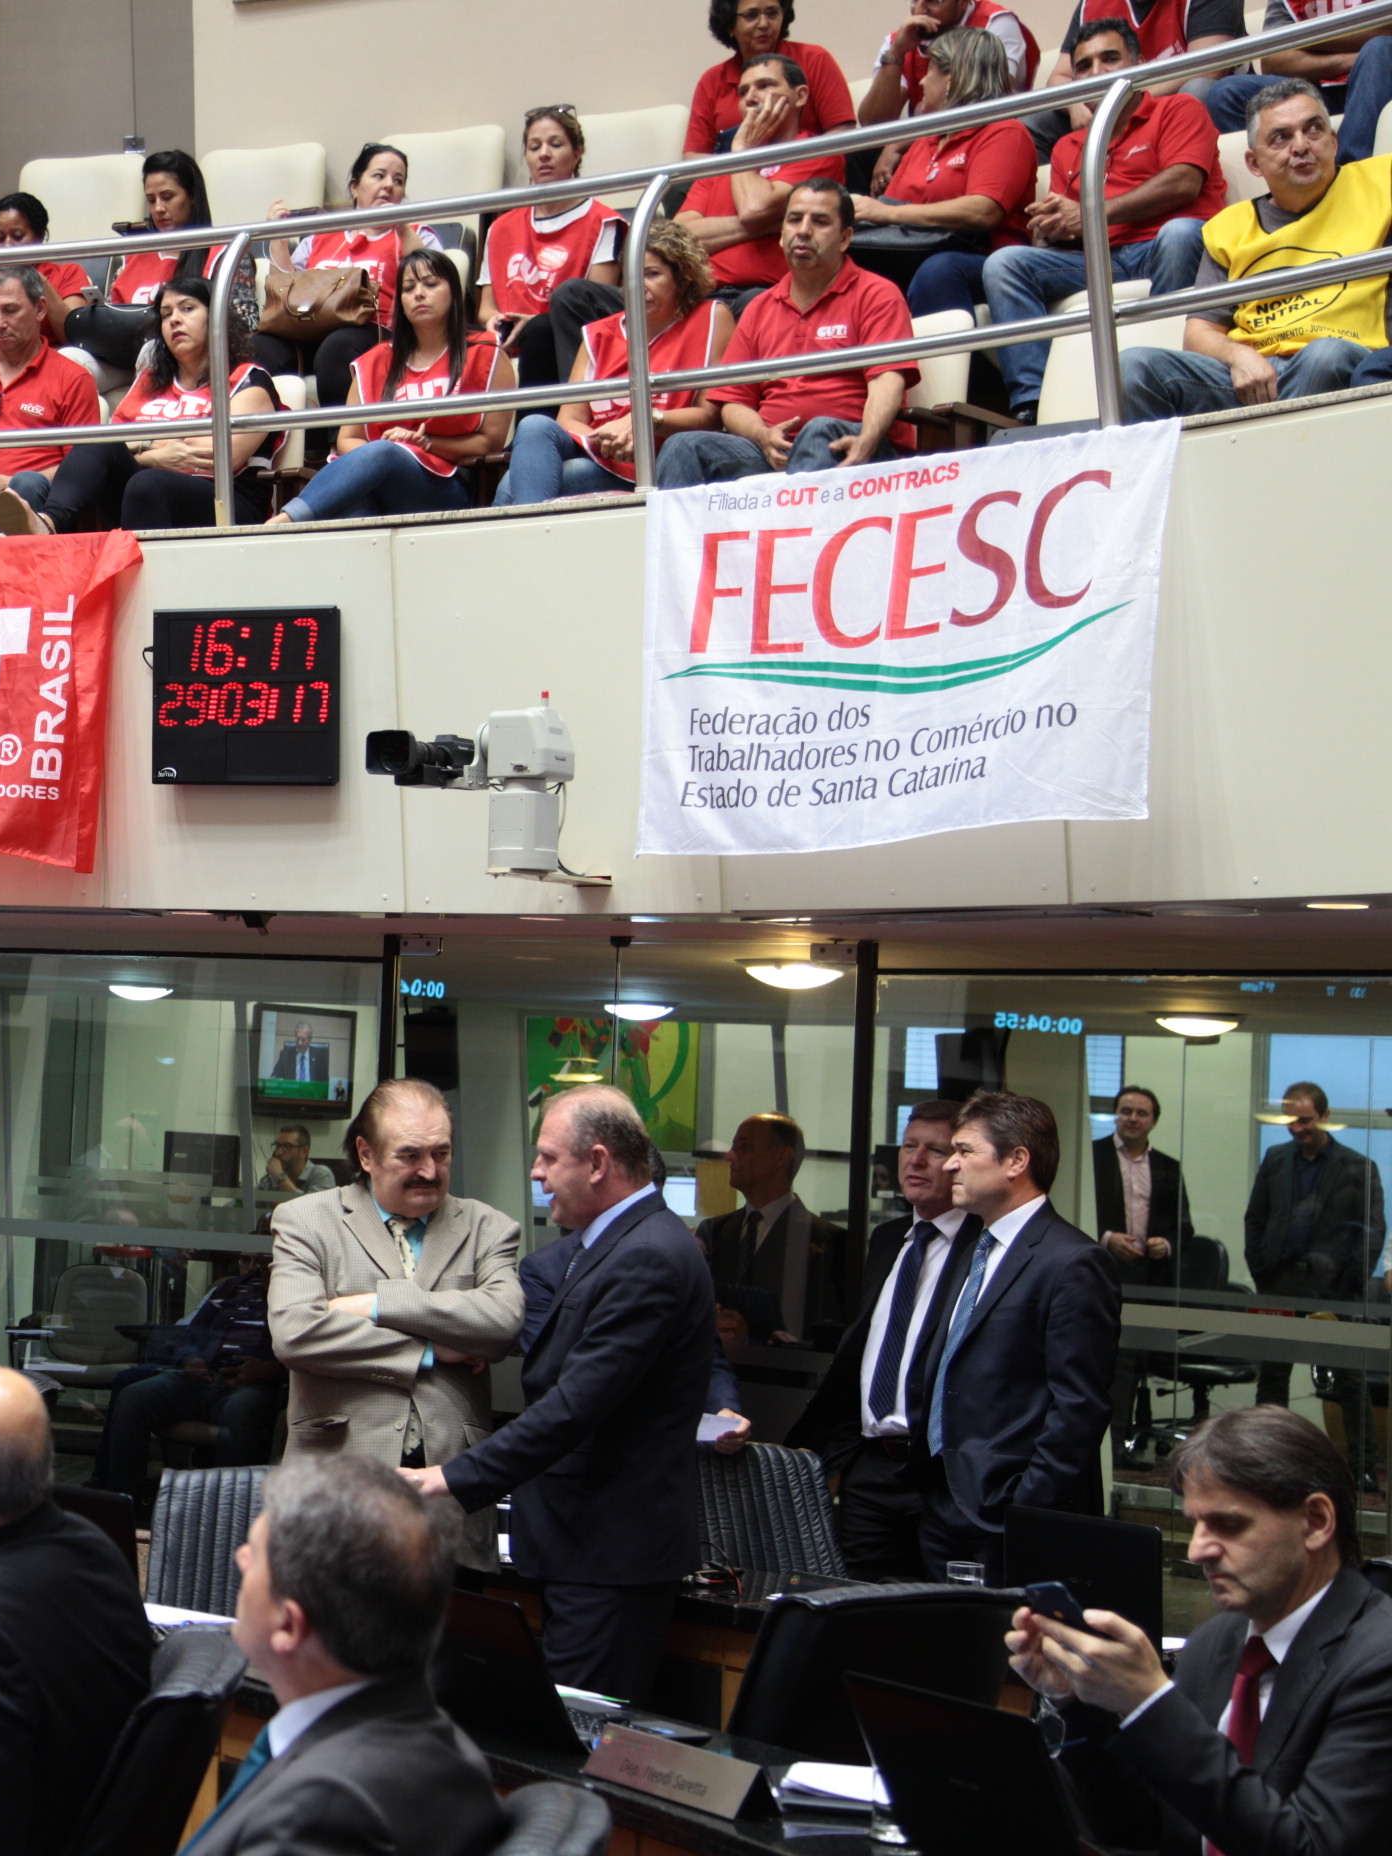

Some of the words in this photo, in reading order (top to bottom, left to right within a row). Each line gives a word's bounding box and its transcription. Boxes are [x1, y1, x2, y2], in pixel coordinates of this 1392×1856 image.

[1247, 298, 1325, 329] ENTRAL
[1256, 295, 1305, 315] NOVA
[140, 394, 207, 418] CUT
[708, 492, 759, 511] Filiada
[761, 494, 772, 508] a
[776, 487, 818, 507] CUT
[821, 489, 830, 504] e
[834, 487, 844, 501] a
[848, 462, 960, 500] CONTRACS
[689, 469, 1112, 655] FECESC
[190, 617, 319, 676] 16:17
[30, 594, 75, 780] BRASIL
[687, 738, 857, 773] Trabalhadores
[864, 736, 901, 764] no
[910, 707, 1026, 757] Comércio
[1035, 701, 1077, 730] no
[689, 706, 818, 742] Federação
[827, 701, 871, 732] dos
[680, 777, 757, 809] Estado
[767, 778, 801, 807] de
[808, 775, 877, 807] Santa
[887, 756, 987, 797] Catarina
[672, 1773, 708, 1798] Saretta
